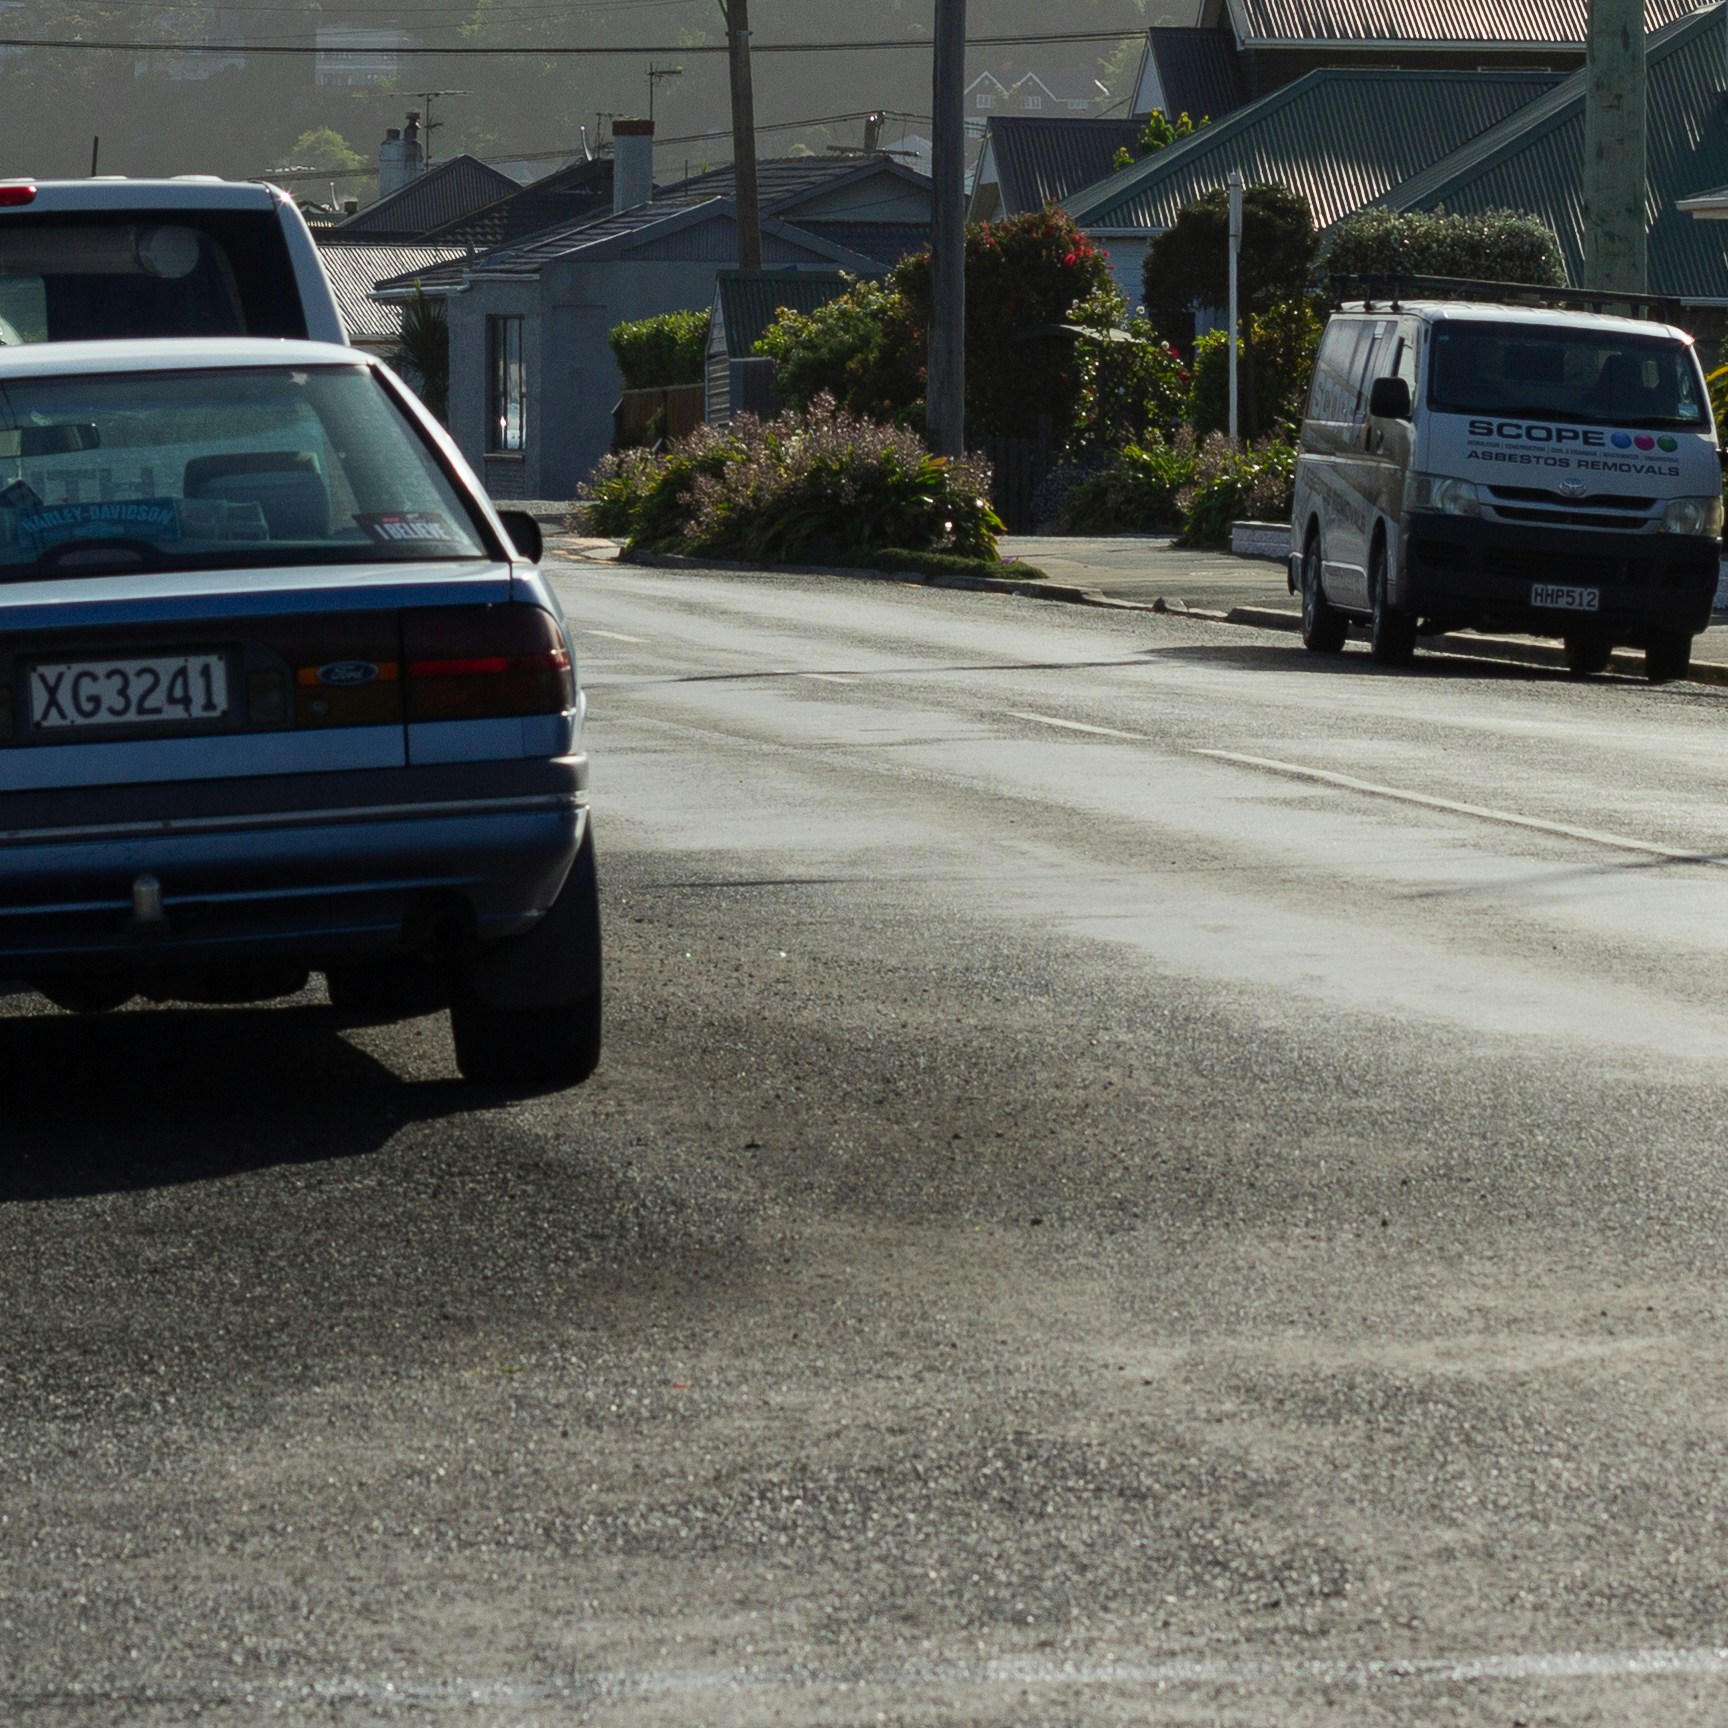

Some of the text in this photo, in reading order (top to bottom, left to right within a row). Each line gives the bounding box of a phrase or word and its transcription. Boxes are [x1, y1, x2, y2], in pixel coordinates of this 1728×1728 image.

[1468, 420, 1606, 447] SCOPE
[1467, 450, 1680, 477] ASBESTOS REMOVALS
[22, 504, 172, 533] HARLEY-DAVIDSON
[373, 523, 451, 540] I BELIEVE
[1534, 586, 1597, 608] HHP512
[38, 662, 218, 721] XG3241
